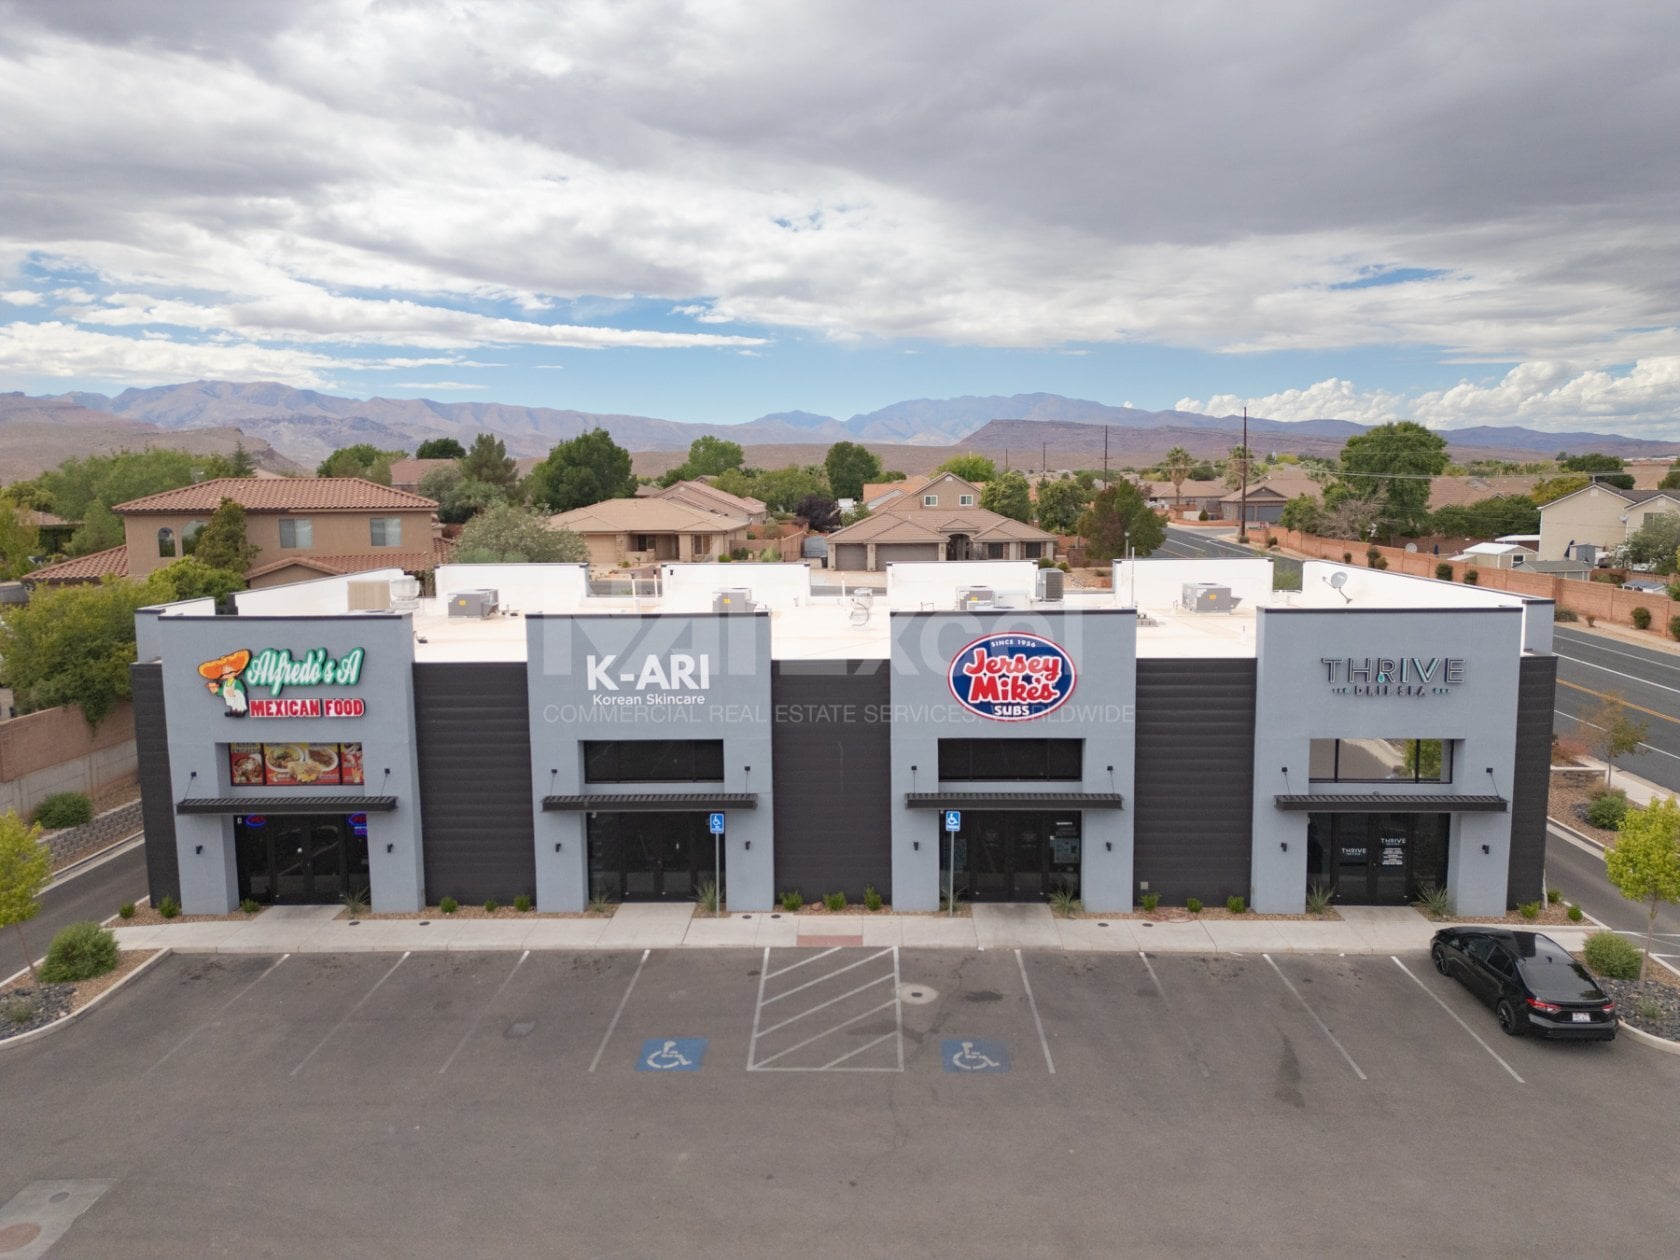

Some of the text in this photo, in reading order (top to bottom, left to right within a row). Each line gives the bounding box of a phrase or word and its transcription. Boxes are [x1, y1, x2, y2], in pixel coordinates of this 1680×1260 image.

[991, 639, 1014, 647] SINCE
[246, 648, 337, 696] Alfredo's
[586, 654, 710, 690] K-ARI
[963, 648, 1062, 682] Jersey
[1321, 657, 1465, 684] THRIVE
[593, 693, 705, 705] Korean Skincare
[968, 676, 1060, 703] Mike's
[250, 698, 365, 717] MEXICAN FOOD
[994, 705, 1030, 716] SUBS
